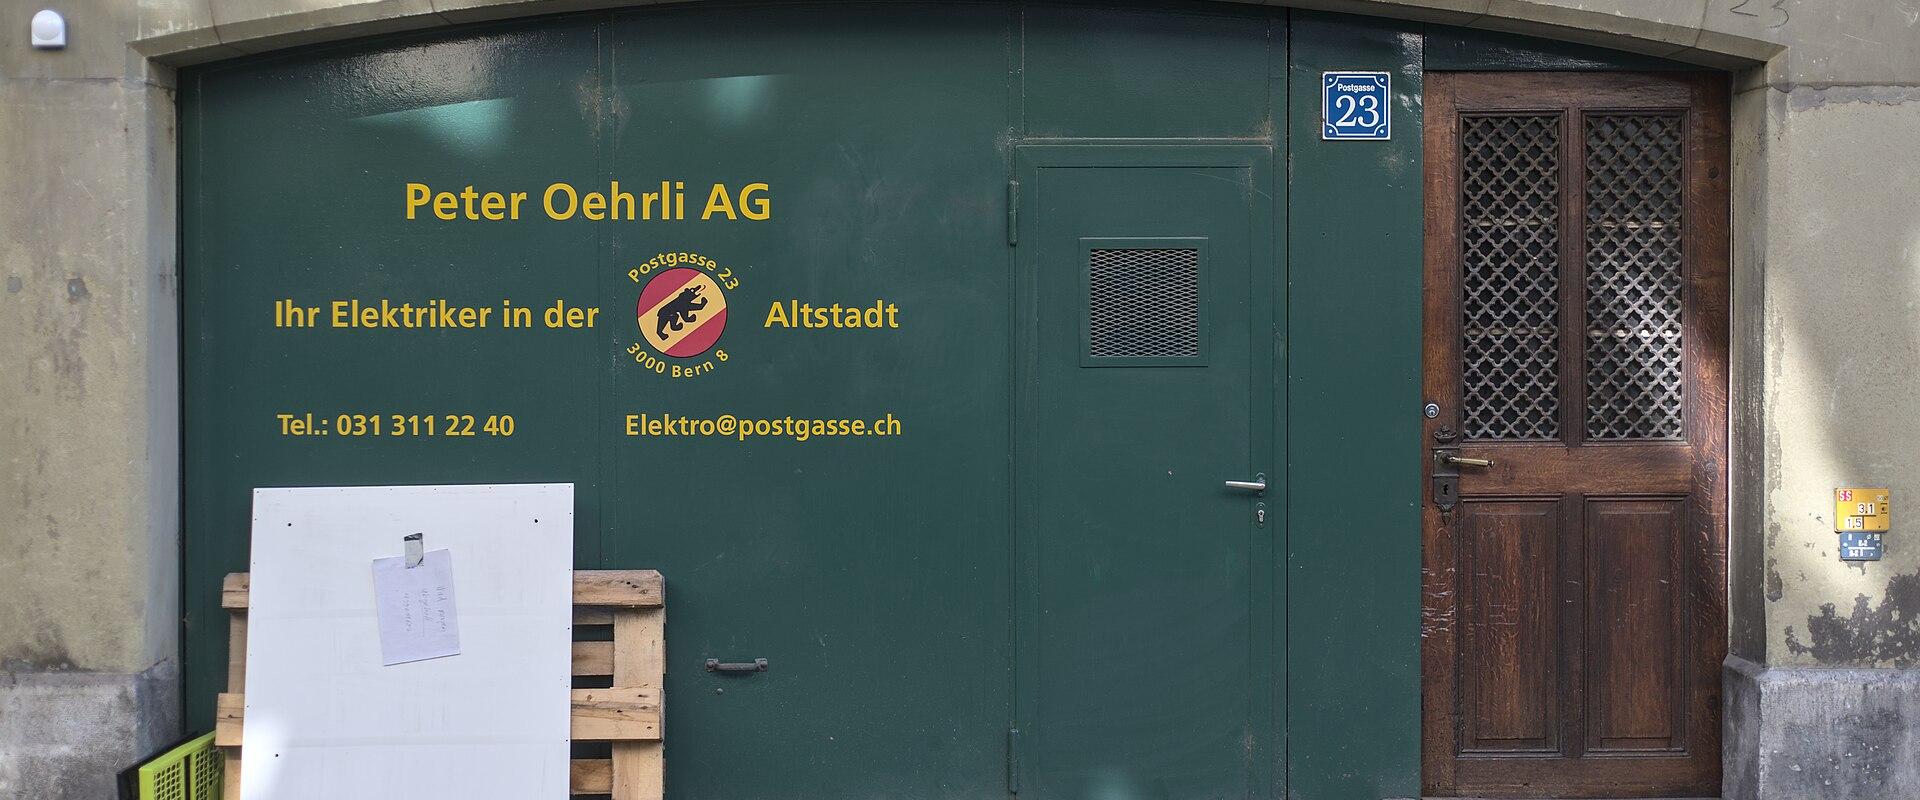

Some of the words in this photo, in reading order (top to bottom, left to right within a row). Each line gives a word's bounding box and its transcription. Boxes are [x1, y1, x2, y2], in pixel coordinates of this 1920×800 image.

[1337, 83, 1376, 93] Postgasse
[1335, 95, 1379, 127] 23
[405, 182, 528, 221] Peter
[542, 180, 685, 221] Oehrli
[701, 182, 771, 221] AG
[627, 252, 717, 283] Postgasse
[717, 267, 740, 291] 23
[275, 300, 321, 328] Ihr
[331, 300, 491, 329] Elektriker
[502, 300, 533, 328] in
[543, 300, 600, 329] der
[764, 300, 899, 329] Altstadt
[626, 342, 666, 373] 3000
[671, 360, 714, 377] Bern
[715, 348, 729, 362] 8
[276, 413, 329, 436] Tel.:
[336, 414, 381, 436] 031
[391, 414, 435, 436] 311
[445, 414, 476, 436] 22
[483, 414, 516, 436] 40
[626, 413, 902, 442] Elektro@postgasse.ch
